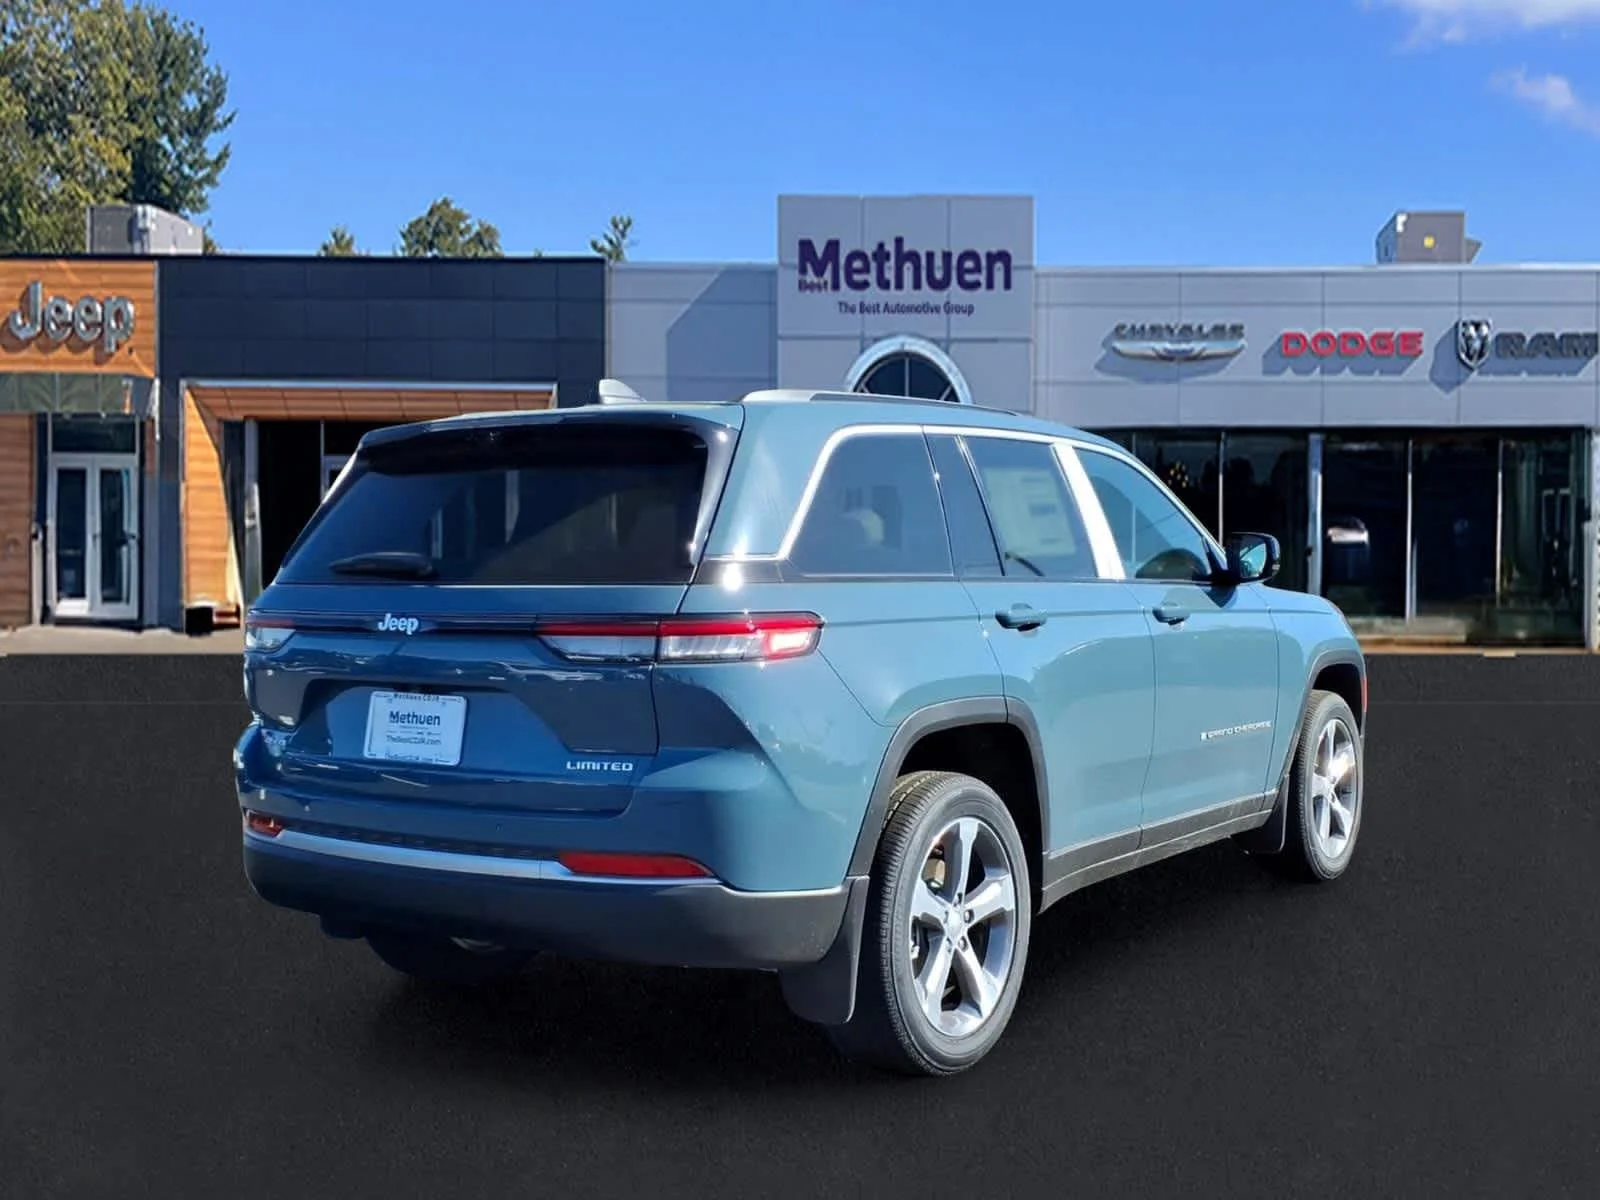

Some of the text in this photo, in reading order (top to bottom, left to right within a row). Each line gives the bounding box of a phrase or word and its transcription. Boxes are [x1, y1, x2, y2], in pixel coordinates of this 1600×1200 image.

[797, 236, 1012, 291] Methuen
[9, 280, 136, 353] Jeep
[838, 301, 975, 317] The Best Automotive Group
[1114, 322, 1245, 341] CHRYSLER
[1281, 331, 1425, 357] DODGE
[1494, 331, 1599, 359] RAM
[377, 612, 419, 635] Jeep
[389, 710, 441, 727] Methuen
[566, 761, 633, 771] LIMITED
